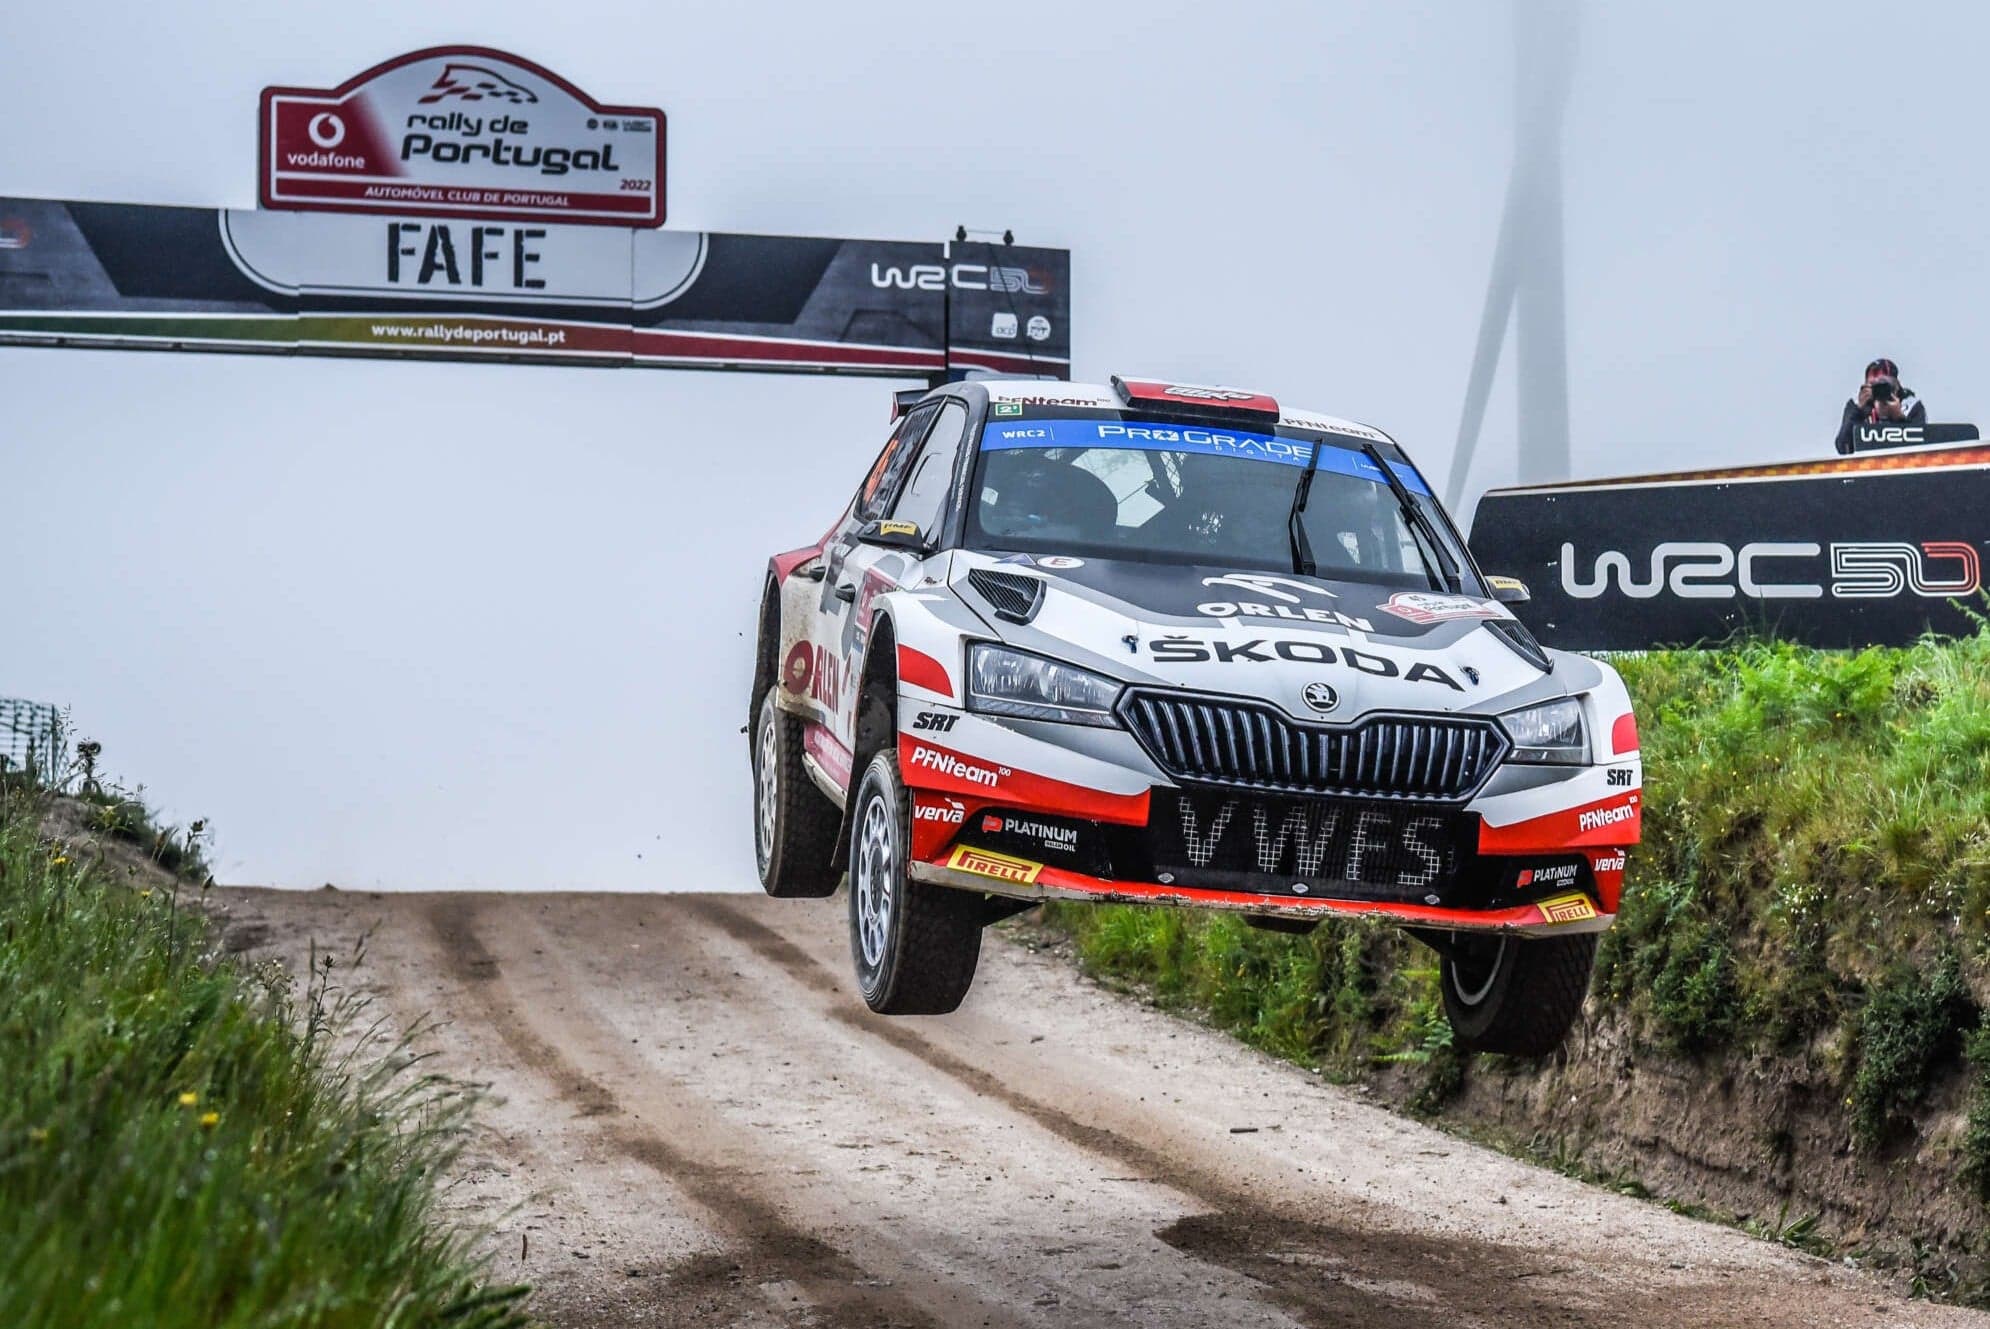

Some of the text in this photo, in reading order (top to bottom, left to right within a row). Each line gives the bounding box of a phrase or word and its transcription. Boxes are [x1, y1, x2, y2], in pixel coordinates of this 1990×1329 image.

[406, 112, 529, 137] rally de
[287, 151, 366, 169] vodafone
[401, 134, 621, 175] Portugal
[364, 186, 570, 206] AUTOMÓVEL CLUB DE PORTUGAL
[620, 179, 651, 191] 2022
[388, 223, 547, 288] FAFE
[371, 323, 567, 345] www.rallydeportugal.pt
[1002, 429, 1047, 439] WRC2
[1860, 427, 1925, 442] WRC
[1197, 601, 1376, 633] ORLEN
[1149, 635, 1466, 692] ŠKODA
[913, 711, 961, 733] SRT
[1606, 768, 1634, 787] SRT
[914, 804, 966, 824] verva
[1005, 818, 1078, 844] PLATINUM
[957, 850, 1034, 882] PIRELLI
[1533, 864, 1578, 883] PLATINUM
[1595, 857, 1626, 872] verva
[1545, 898, 1591, 923] PIRELLI
